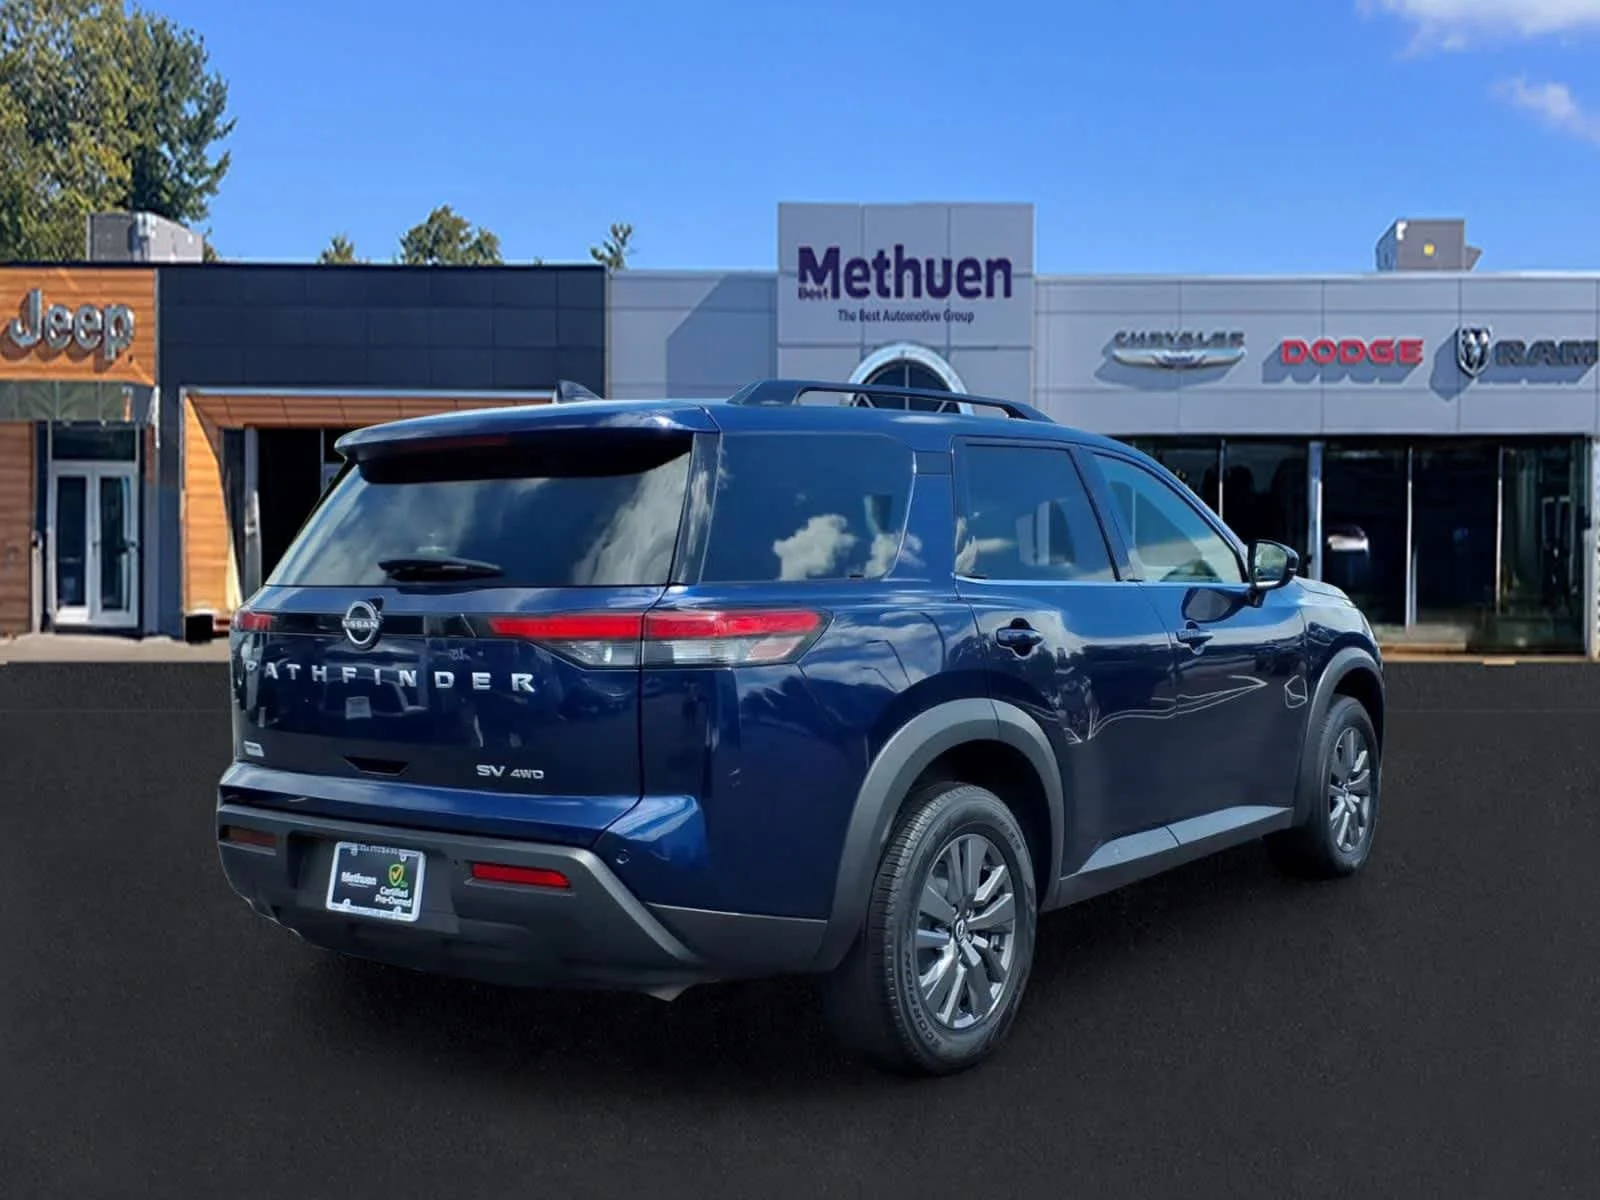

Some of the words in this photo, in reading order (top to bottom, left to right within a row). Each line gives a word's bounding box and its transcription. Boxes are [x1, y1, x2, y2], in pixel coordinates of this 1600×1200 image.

[798, 244, 1012, 299] Methuen
[9, 288, 135, 361] Jeep
[838, 308, 857, 322] The
[859, 308, 881, 322] Best
[883, 308, 941, 323] Automotive
[943, 308, 975, 324] Group
[1114, 331, 1244, 348] CHRYSLER
[1281, 338, 1424, 365] DODGE
[1495, 339, 1599, 367] RAM
[342, 619, 379, 629] NISSAN
[246, 660, 536, 692] PATHFINDER
[476, 764, 505, 777] SV
[510, 769, 545, 779] 4WD
